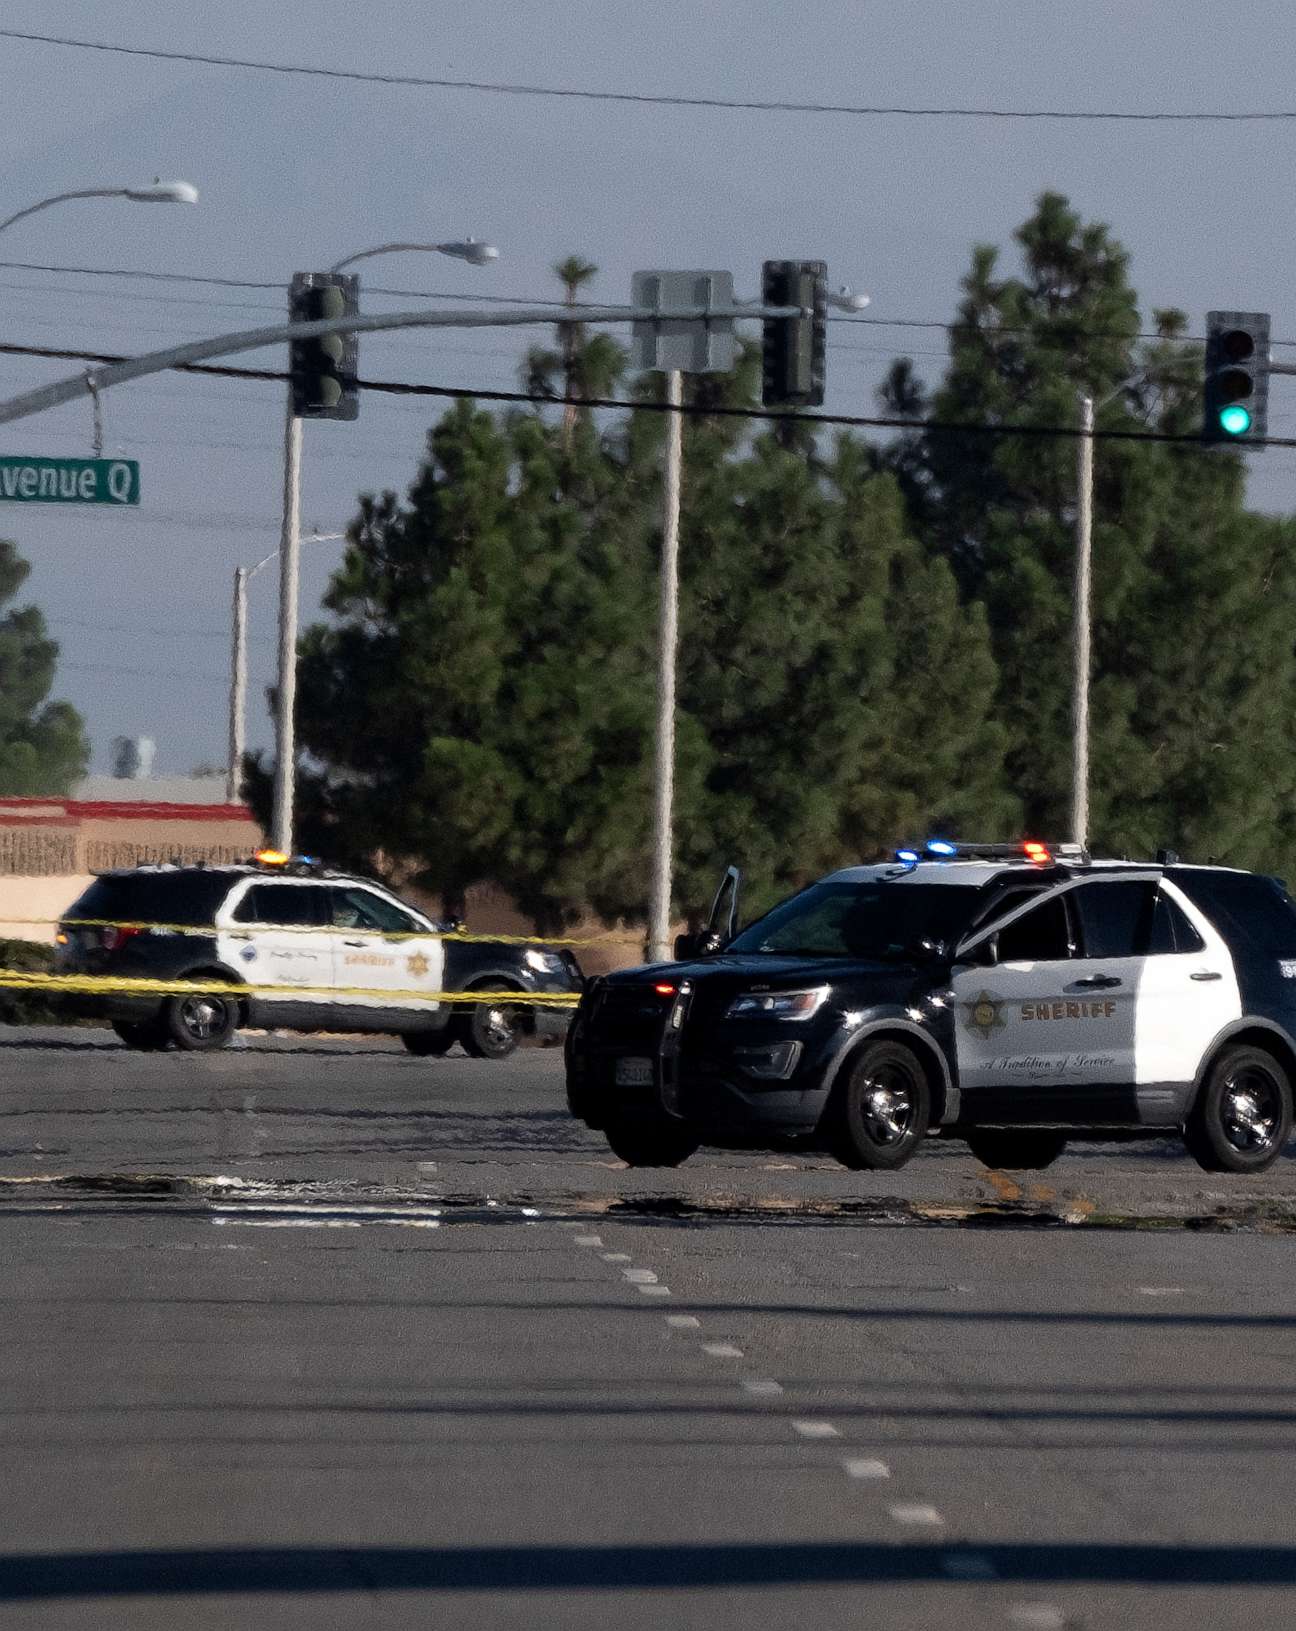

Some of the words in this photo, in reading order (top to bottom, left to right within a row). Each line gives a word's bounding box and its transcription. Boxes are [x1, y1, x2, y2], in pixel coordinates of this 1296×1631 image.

[0, 467, 97, 499] venue
[108, 463, 132, 503] Q
[1020, 1001, 1117, 1022] SHERIFF
[999, 1056, 1051, 1071] Tradition
[1056, 1055, 1070, 1073] of
[1073, 1055, 1117, 1068] Service
